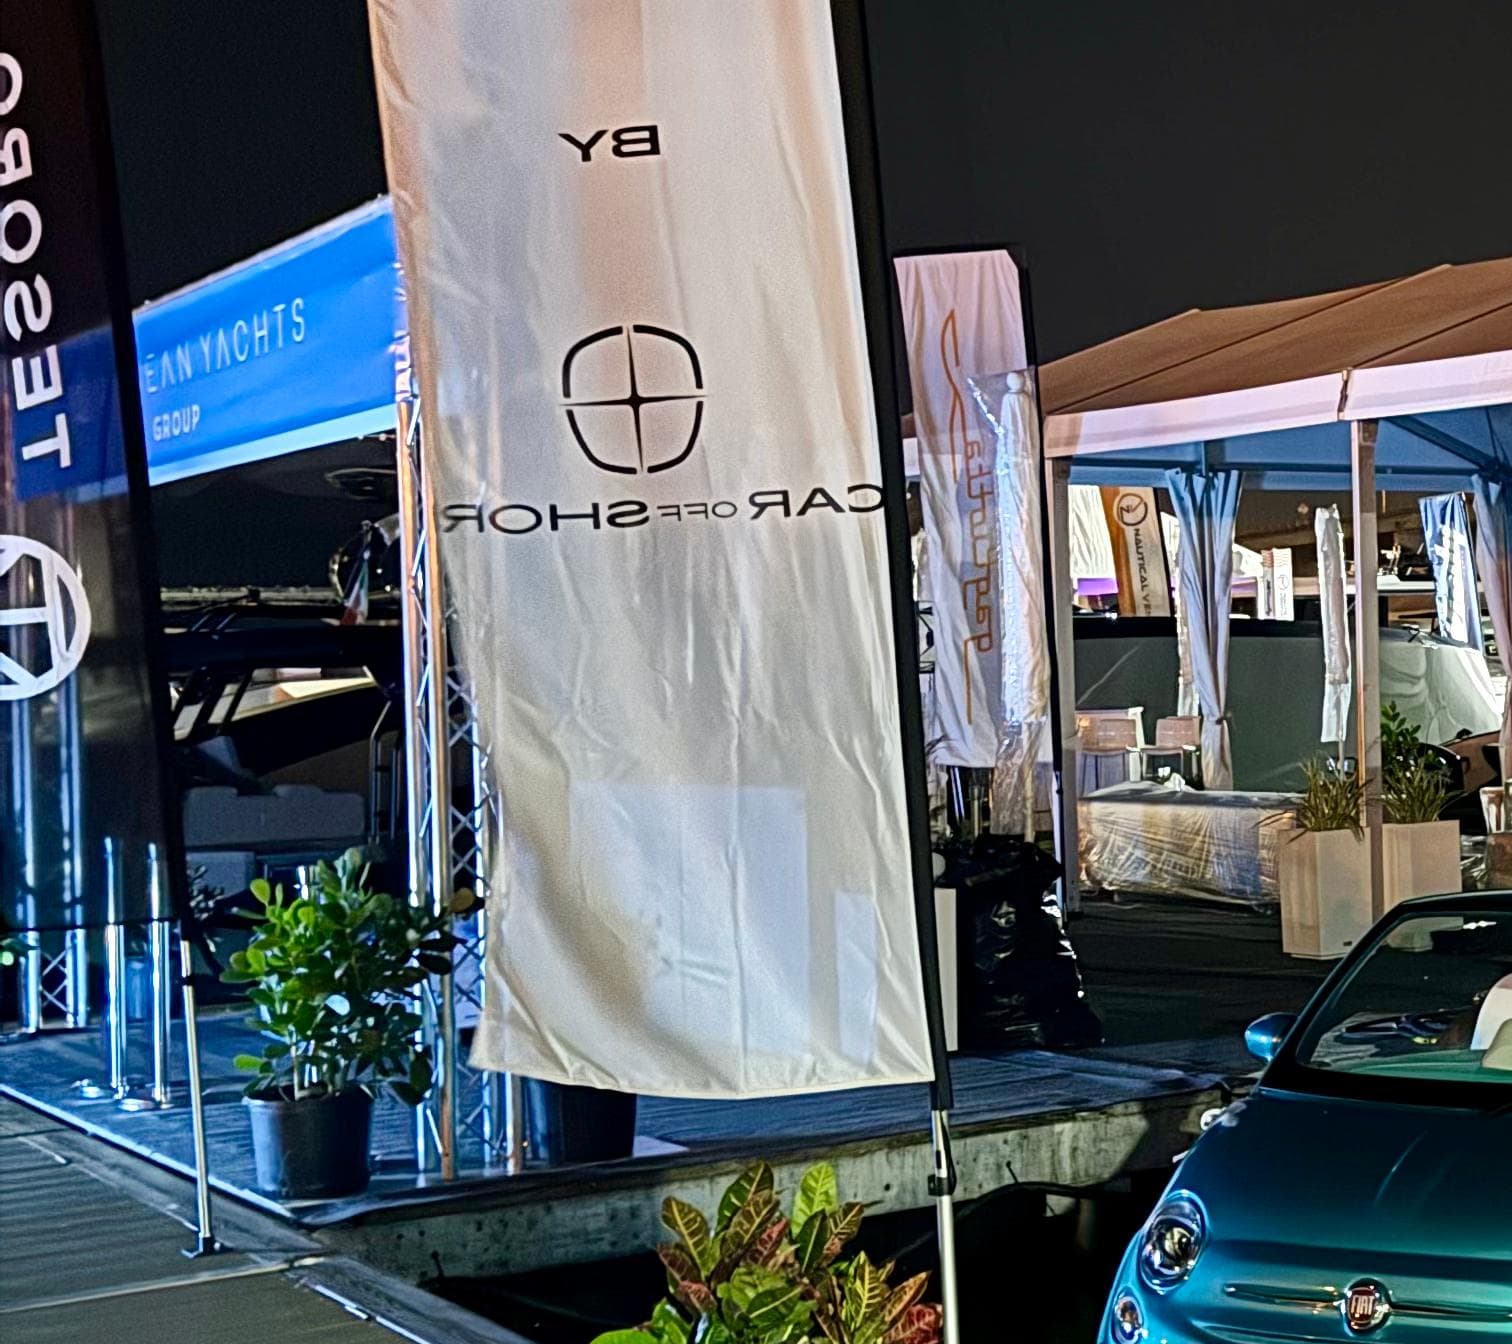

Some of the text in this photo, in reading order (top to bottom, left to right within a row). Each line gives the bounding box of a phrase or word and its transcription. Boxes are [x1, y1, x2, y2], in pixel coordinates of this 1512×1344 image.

[200, 297, 305, 374] YACHTS
[152, 404, 201, 442] GROUP
[1133, 527, 1149, 593] NAUTICAL
[1350, 1295, 1375, 1316] FIAT
